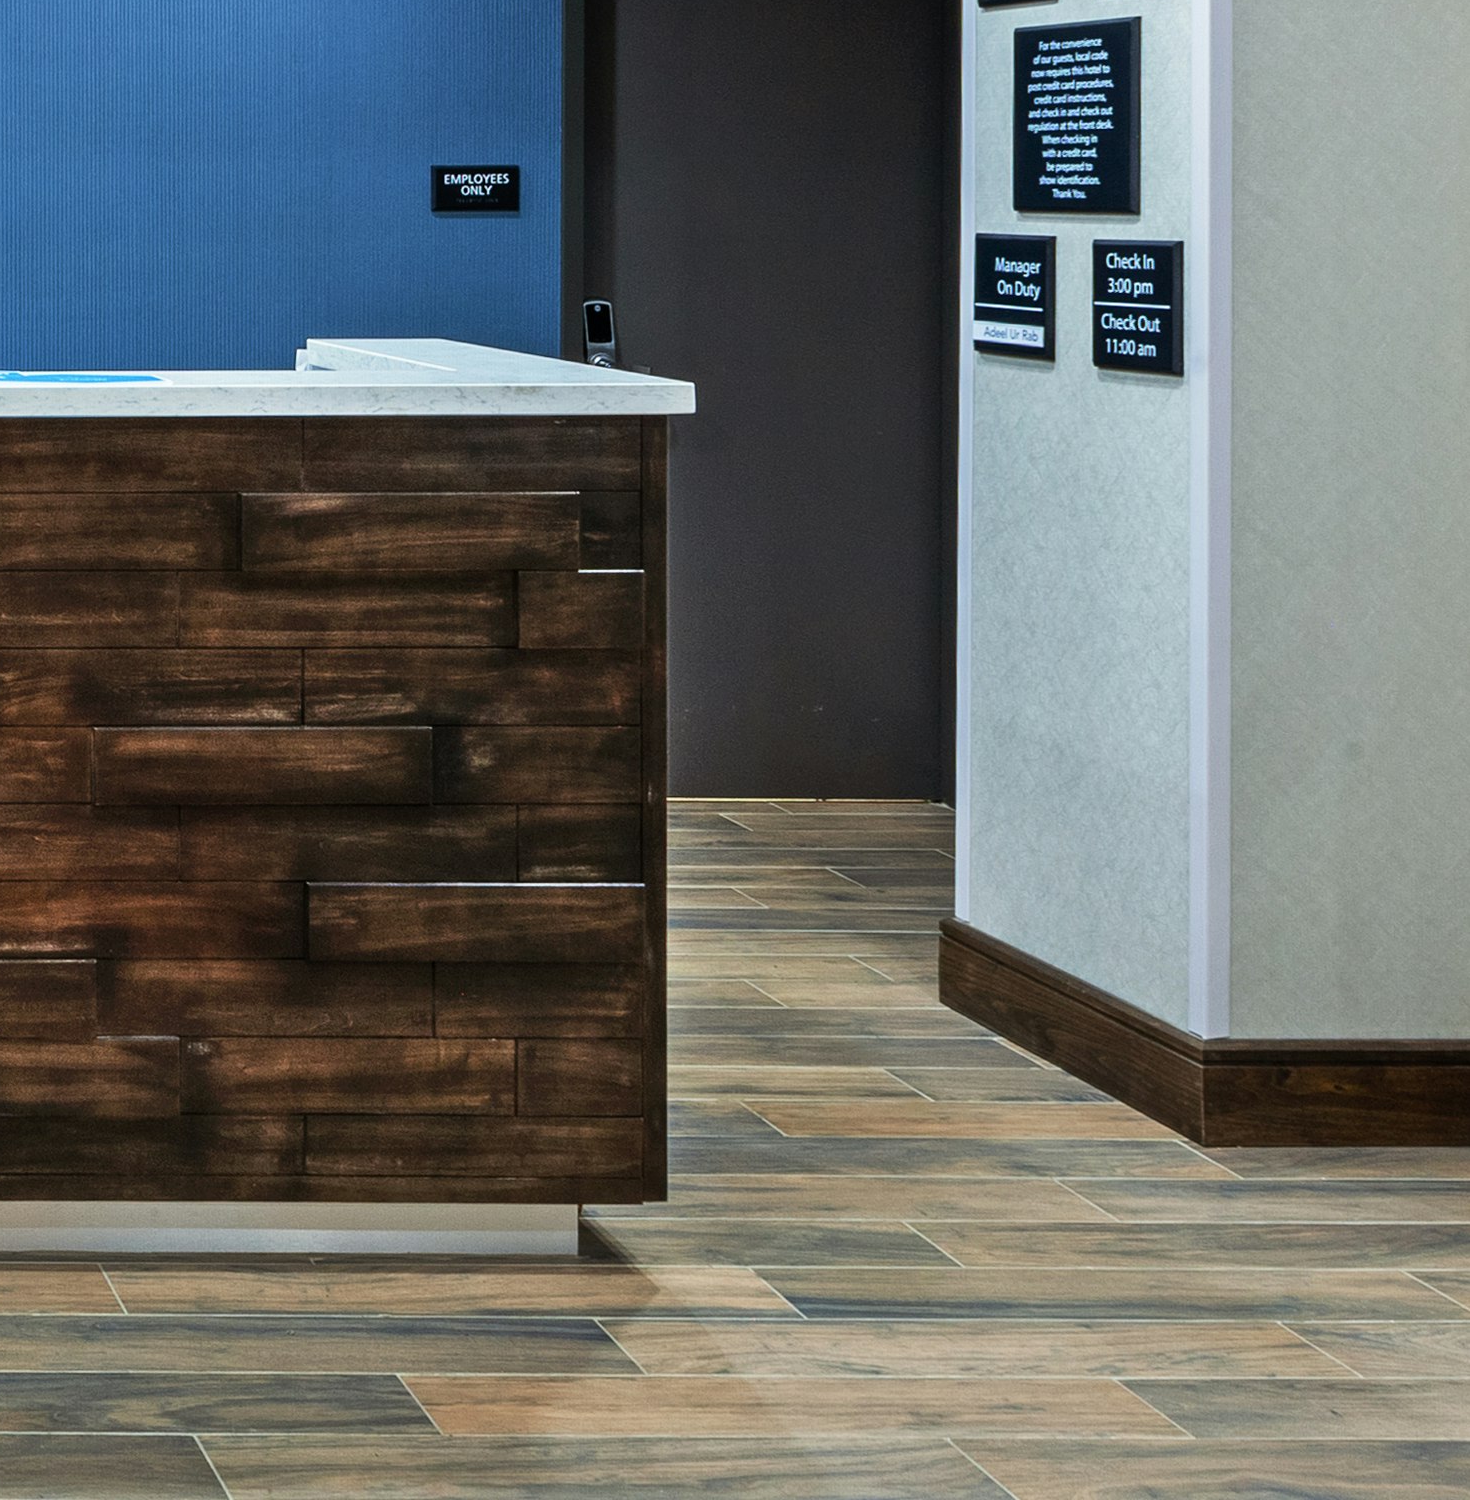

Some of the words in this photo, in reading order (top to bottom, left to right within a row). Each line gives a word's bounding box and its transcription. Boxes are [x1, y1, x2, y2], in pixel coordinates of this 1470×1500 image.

[1039, 41, 1048, 51] For
[1050, 41, 1060, 50] the
[1062, 38, 1102, 49] convenience
[1033, 54, 1041, 65] of
[1041, 56, 1051, 64] our
[1075, 51, 1091, 61] local
[1091, 50, 1108, 60] code
[1031, 70, 1044, 78] now
[1046, 67, 1071, 78] requires
[1072, 65, 1083, 75] this
[1084, 64, 1101, 74] hotel
[1103, 65, 1110, 73] to
[1028, 83, 1042, 94] post
[1042, 81, 1060, 91] credit
[1060, 79, 1075, 89] card
[1034, 94, 1052, 104] credit
[1053, 94, 1067, 103] card
[1028, 109, 1041, 118] and
[1042, 107, 1058, 117] check
[1060, 108, 1066, 116] in
[1067, 107, 1080, 117] and
[1081, 106, 1099, 116] check
[1101, 106, 1113, 115] out
[1027, 122, 1059, 134] regulation
[1060, 122, 1066, 130] at
[1067, 121, 1078, 130] the
[1079, 120, 1095, 130] front
[1042, 135, 1060, 144] When
[1061, 134, 1090, 146] checking
[1091, 134, 1098, 143] in
[1042, 148, 1056, 157] with
[1062, 148, 1080, 157] credit
[1046, 162, 1054, 171] be
[1055, 162, 1084, 173] prepared
[1085, 163, 1093, 171] to
[444, 173, 509, 184] EMPLOYEES
[1039, 175, 1056, 185] show
[461, 185, 492, 195] ONLY
[1052, 188, 1072, 198] Thank
[995, 257, 1041, 277] Manager
[1106, 253, 1141, 270] Check
[1143, 254, 1155, 270] In
[997, 280, 1013, 295] On
[1015, 281, 1041, 301] Duty
[1108, 278, 1131, 294] 3:00
[1134, 283, 1153, 297] pm
[1101, 313, 1136, 331] Check
[1138, 316, 1161, 333] Out
[984, 326, 1008, 338] Adeel
[1105, 339, 1135, 355] 11:00
[1137, 344, 1156, 357] am
